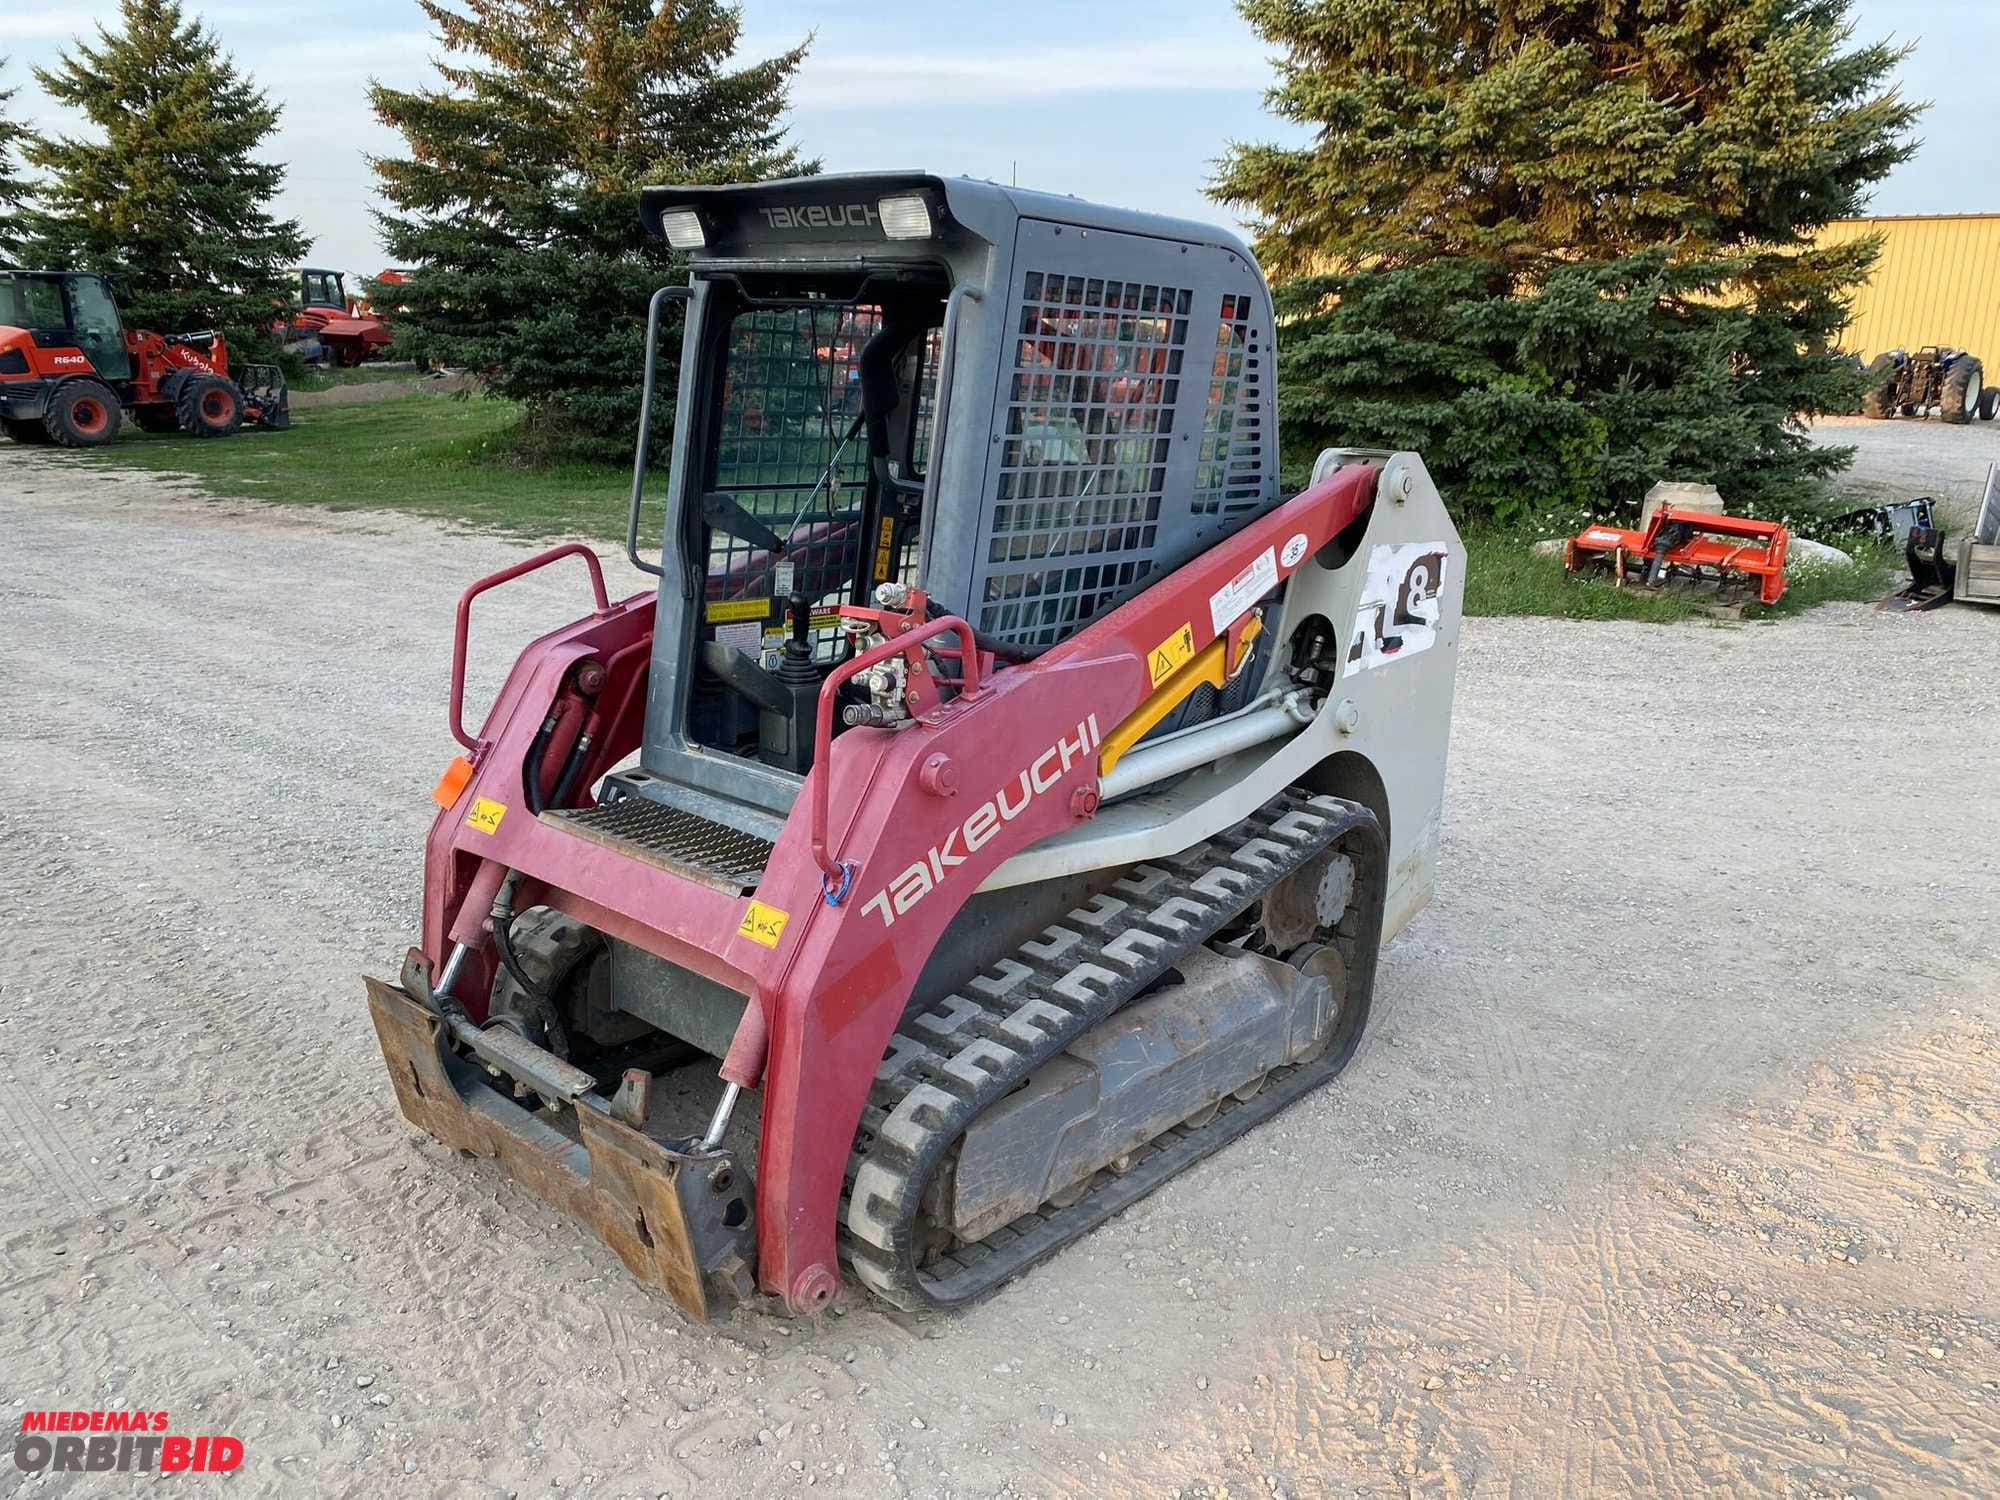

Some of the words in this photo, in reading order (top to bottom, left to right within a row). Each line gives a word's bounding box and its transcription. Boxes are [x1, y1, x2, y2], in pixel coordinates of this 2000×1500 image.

[758, 204, 880, 229] TAKEUCH
[54, 356, 85, 364] R640
[180, 348, 214, 375] Kubota
[860, 713, 1101, 928] TAKEUCHI
